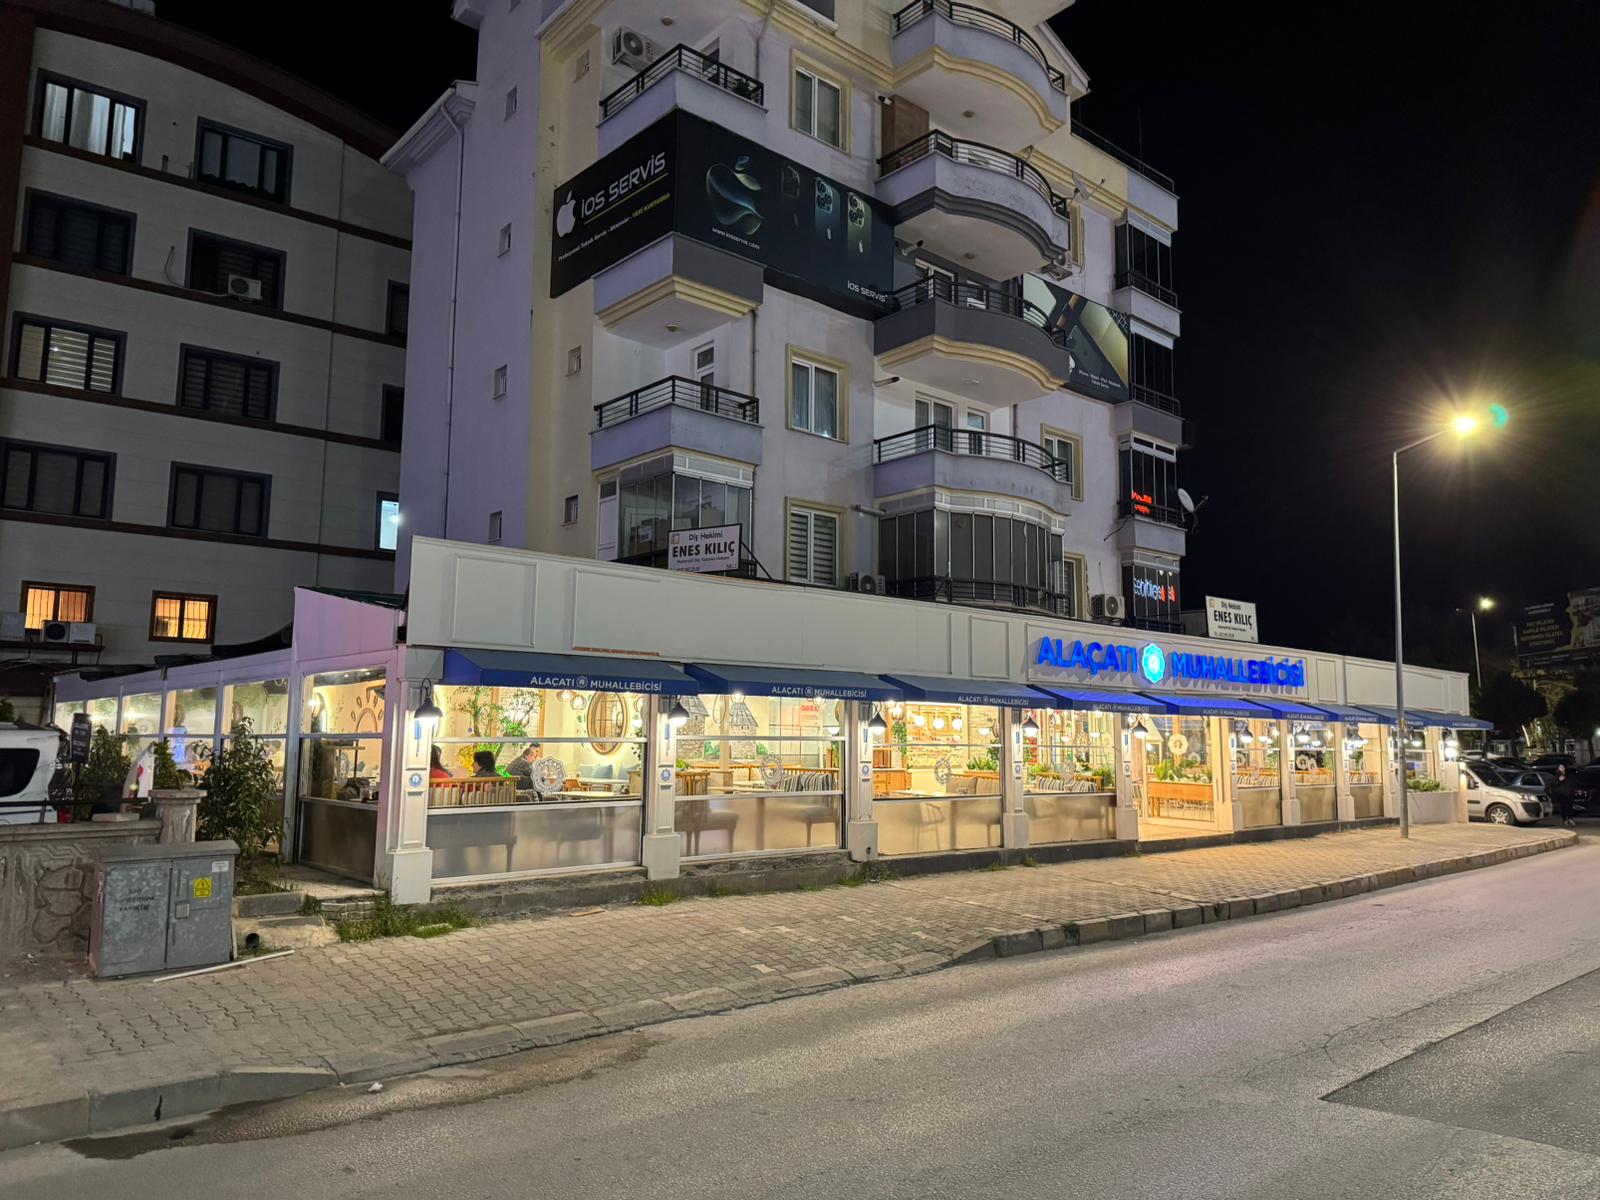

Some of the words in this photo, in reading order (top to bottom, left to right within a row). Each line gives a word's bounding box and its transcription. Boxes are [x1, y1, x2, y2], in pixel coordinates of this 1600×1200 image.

[689, 533, 698, 541] Diş
[700, 531, 722, 540] Hekimi
[672, 544, 700, 557] ENES
[705, 541, 735, 556] KILIÇ
[1214, 610, 1232, 623] ENES
[1234, 612, 1253, 630] KILIÇ
[1037, 636, 1138, 674] ALAÇATI
[1171, 651, 1305, 687] MUHALLEBİCİSİ
[530, 676, 575, 688] ALAÇATI
[589, 680, 663, 692] MUHALLEBİCİSİ
[771, 685, 804, 696] ALAÇATI
[813, 688, 868, 699] MUHALLEBİCİSİ
